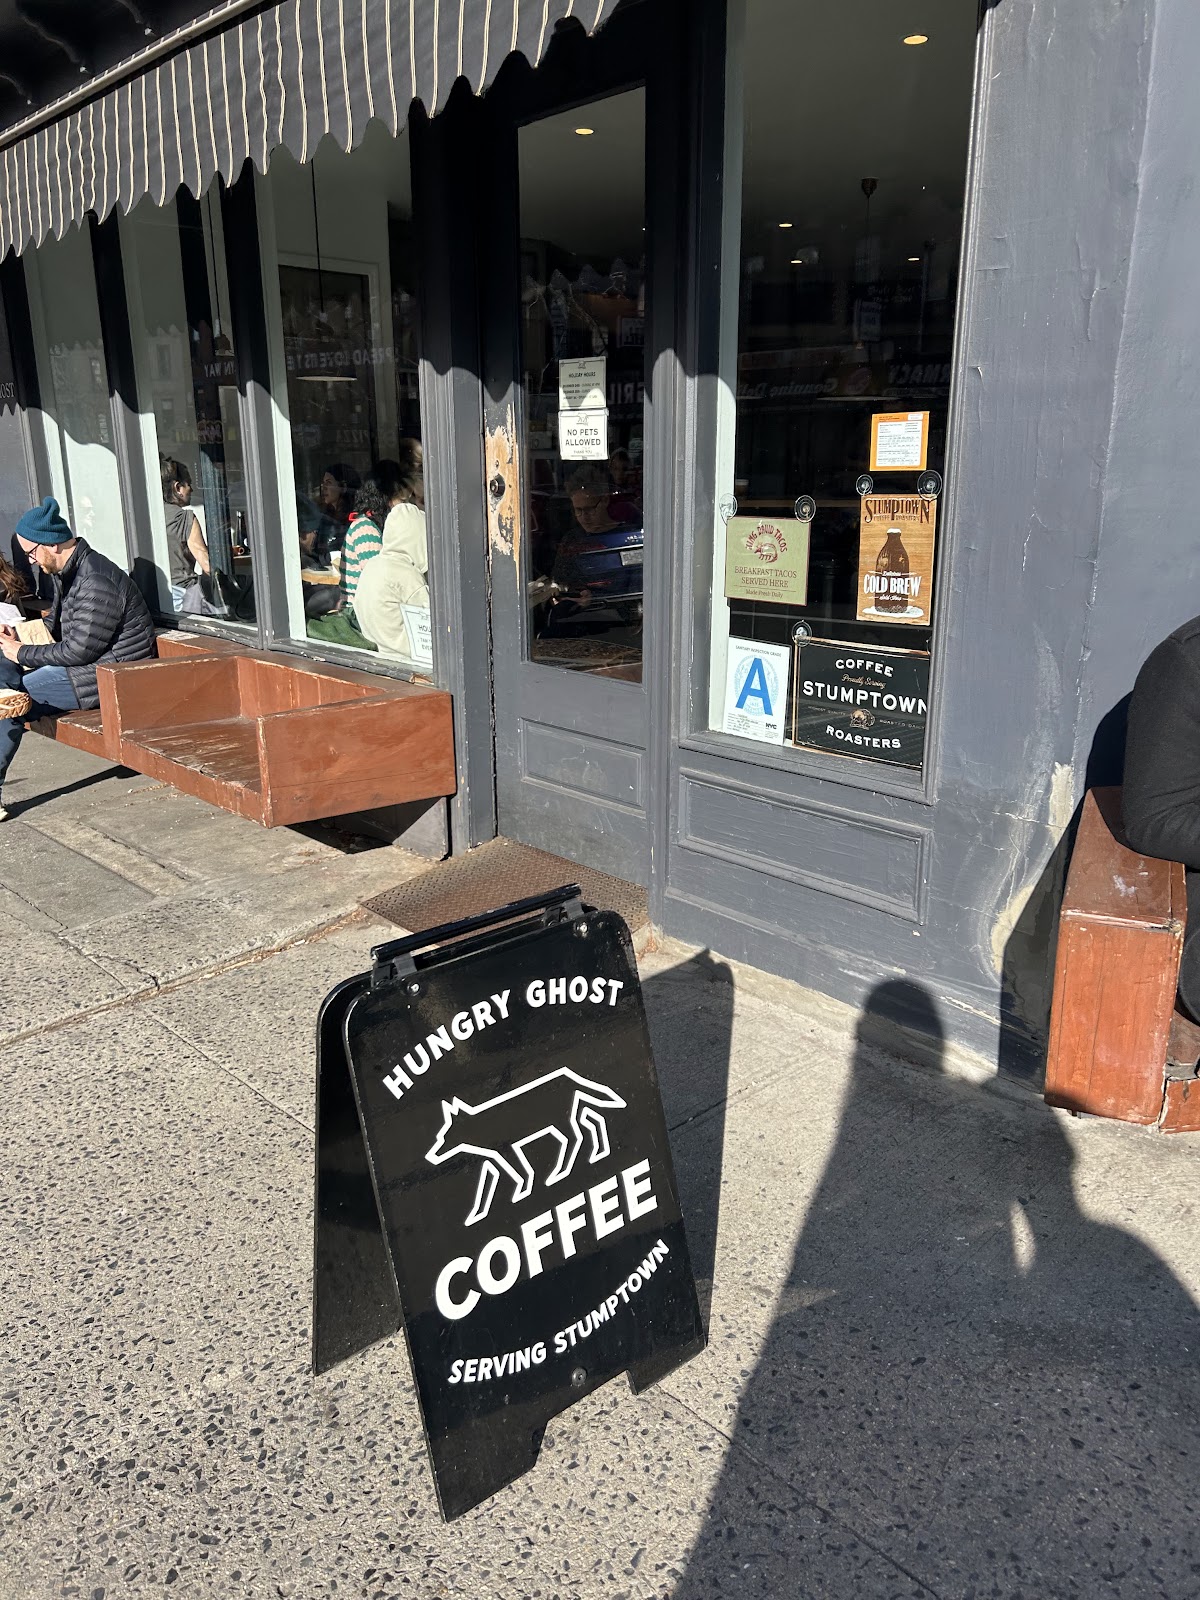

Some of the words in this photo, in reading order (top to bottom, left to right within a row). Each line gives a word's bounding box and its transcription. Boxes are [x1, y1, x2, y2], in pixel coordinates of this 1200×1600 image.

[0, 382, 15, 398] OST
[565, 438, 601, 447] ALLOWED
[579, 428, 599, 436] PETS
[864, 499, 930, 524] STUMPTOWN
[774, 528, 788, 553] TACOS
[734, 565, 774, 577] BREAKFAST
[775, 569, 798, 579] TACOS
[741, 576, 769, 586] SERVED
[769, 579, 789, 588] HERE
[771, 591, 784, 599] Daily
[863, 573, 889, 594] COLD
[889, 575, 922, 598] BREW
[835, 658, 894, 678] COFFEE
[735, 657, 774, 717] A
[841, 673, 865, 687] Proudly
[864, 676, 887, 690] Serving
[802, 680, 928, 715] STUMPTOWN
[765, 722, 778, 730] NYC
[825, 724, 902, 749] ROASTERS
[381, 989, 511, 1100] HUNGRY
[525, 975, 625, 1008] GHOST
[434, 1157, 658, 1321] COFFEE
[447, 1340, 548, 1384] SERVING
[553, 1238, 670, 1355] STUMPTOWN
